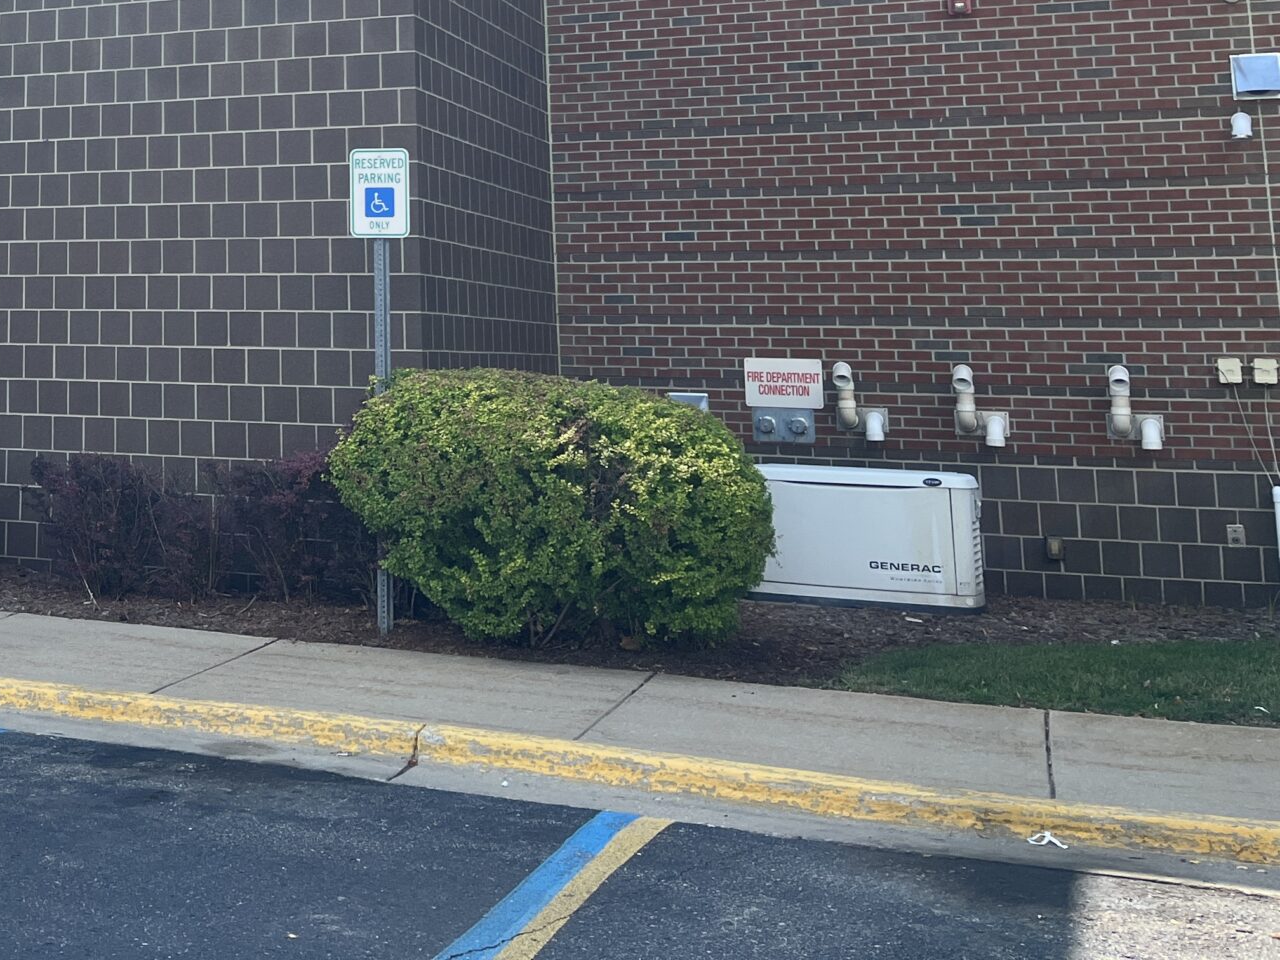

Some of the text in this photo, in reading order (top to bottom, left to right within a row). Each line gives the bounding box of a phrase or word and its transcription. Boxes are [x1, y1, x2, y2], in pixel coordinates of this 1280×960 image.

[354, 158, 404, 169] RESERVED
[358, 173, 401, 184] PARKING
[369, 221, 390, 229] ONLY
[746, 371, 820, 384] FIRE DEPARTMENT
[758, 384, 810, 396] CONNECTION
[869, 561, 942, 573] GENERAC
